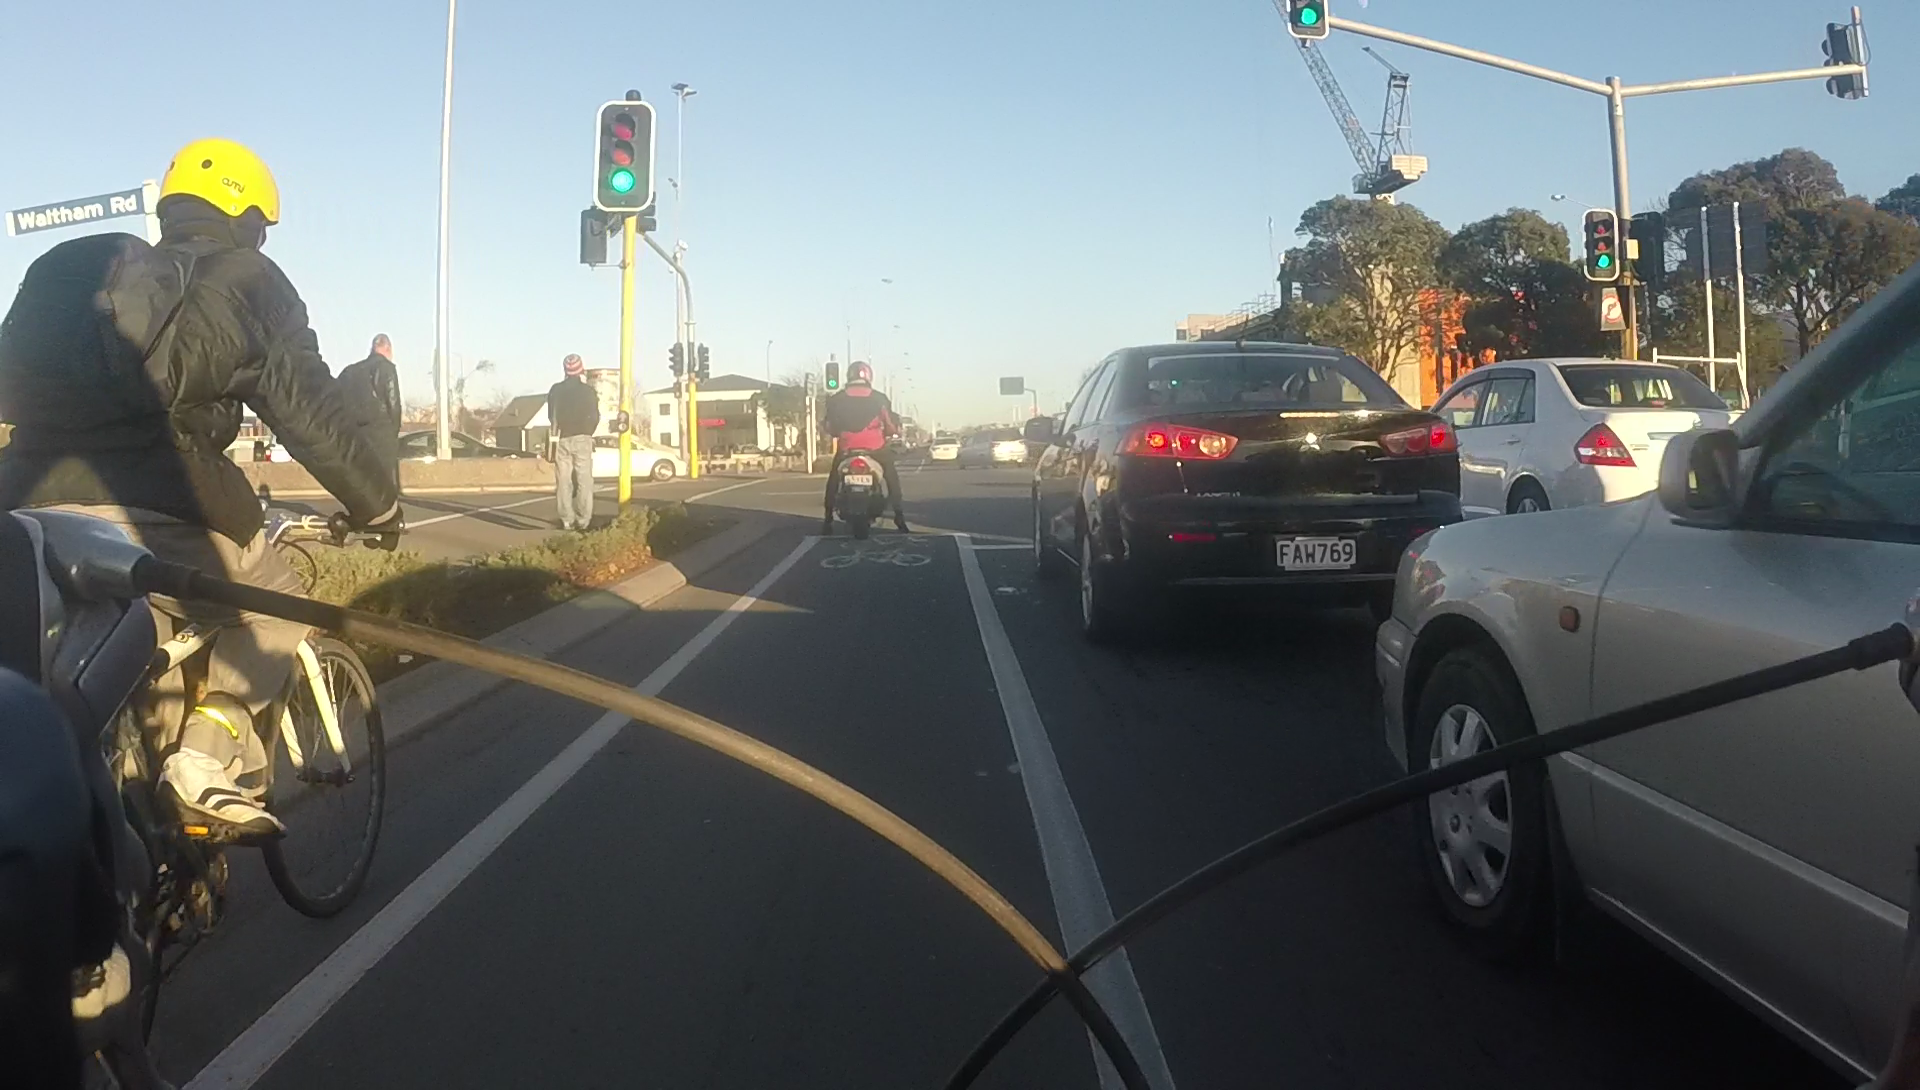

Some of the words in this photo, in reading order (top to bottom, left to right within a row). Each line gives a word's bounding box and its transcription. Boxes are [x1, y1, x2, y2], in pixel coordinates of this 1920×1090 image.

[17, 203, 104, 230] Waltham
[109, 194, 138, 214] Rd
[1279, 543, 1354, 564] FAW769
